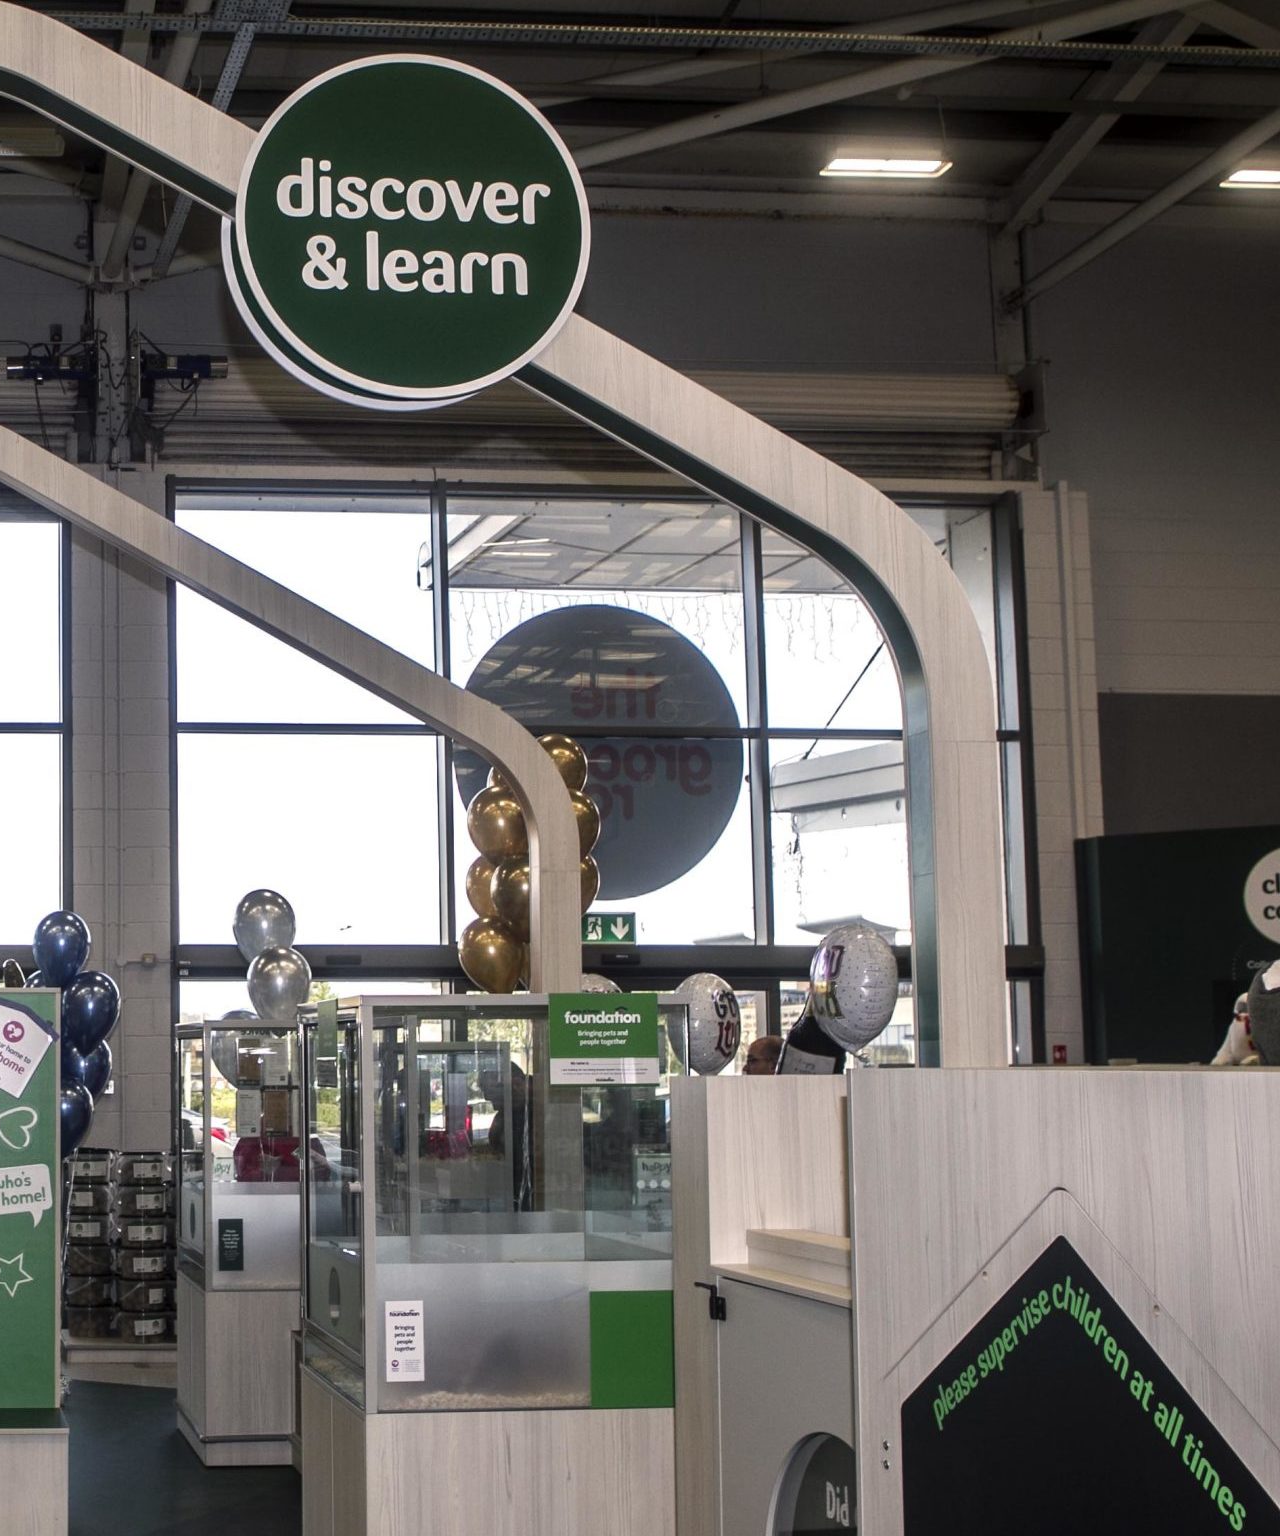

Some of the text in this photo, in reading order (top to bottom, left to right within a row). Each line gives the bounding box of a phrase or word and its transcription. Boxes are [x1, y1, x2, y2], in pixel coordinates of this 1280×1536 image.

[275, 157, 551, 225] discover
[301, 230, 528, 296] & learn
[564, 1010, 641, 1024] foundation
[577, 1029, 602, 1037] Bringing
[579, 1038, 627, 1047] people together
[5, 1045, 24, 1060] home
[23, 1056, 32, 1064] to
[1, 1187, 47, 1207] home!
[932, 1275, 1247, 1532] please supervise children at all times
[825, 1480, 850, 1527] Did
